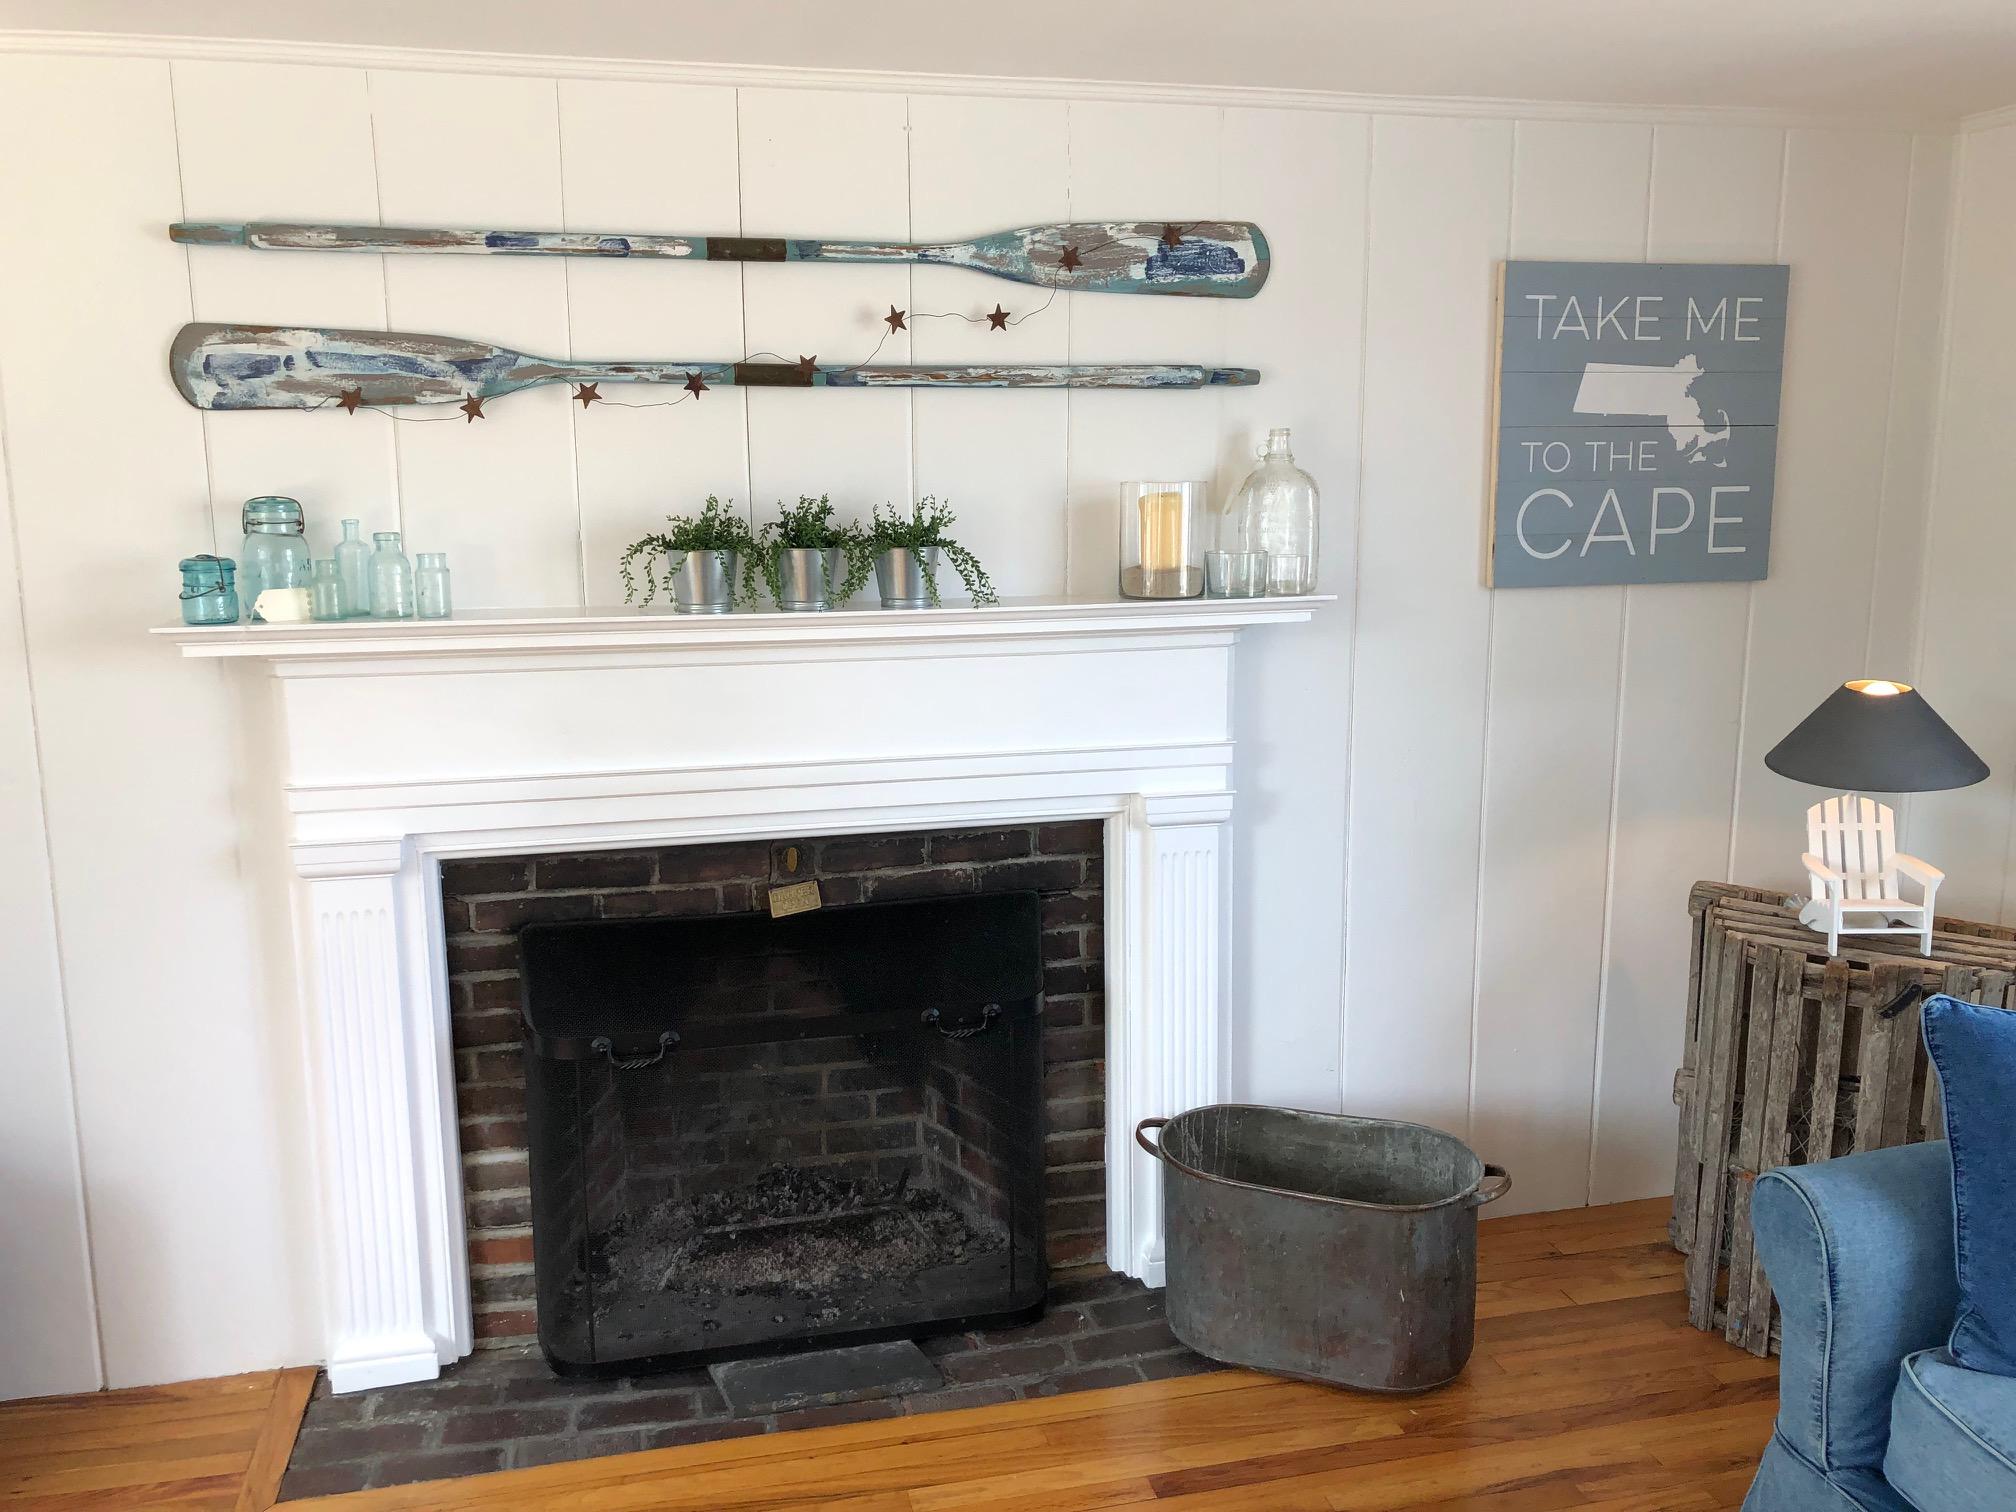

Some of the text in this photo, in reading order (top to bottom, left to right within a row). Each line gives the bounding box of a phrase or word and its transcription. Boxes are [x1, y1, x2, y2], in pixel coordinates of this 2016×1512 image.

[1526, 295, 1763, 342] TAKE ME
[1520, 441, 1659, 473] TO THE
[1516, 486, 1750, 559] CAPE
